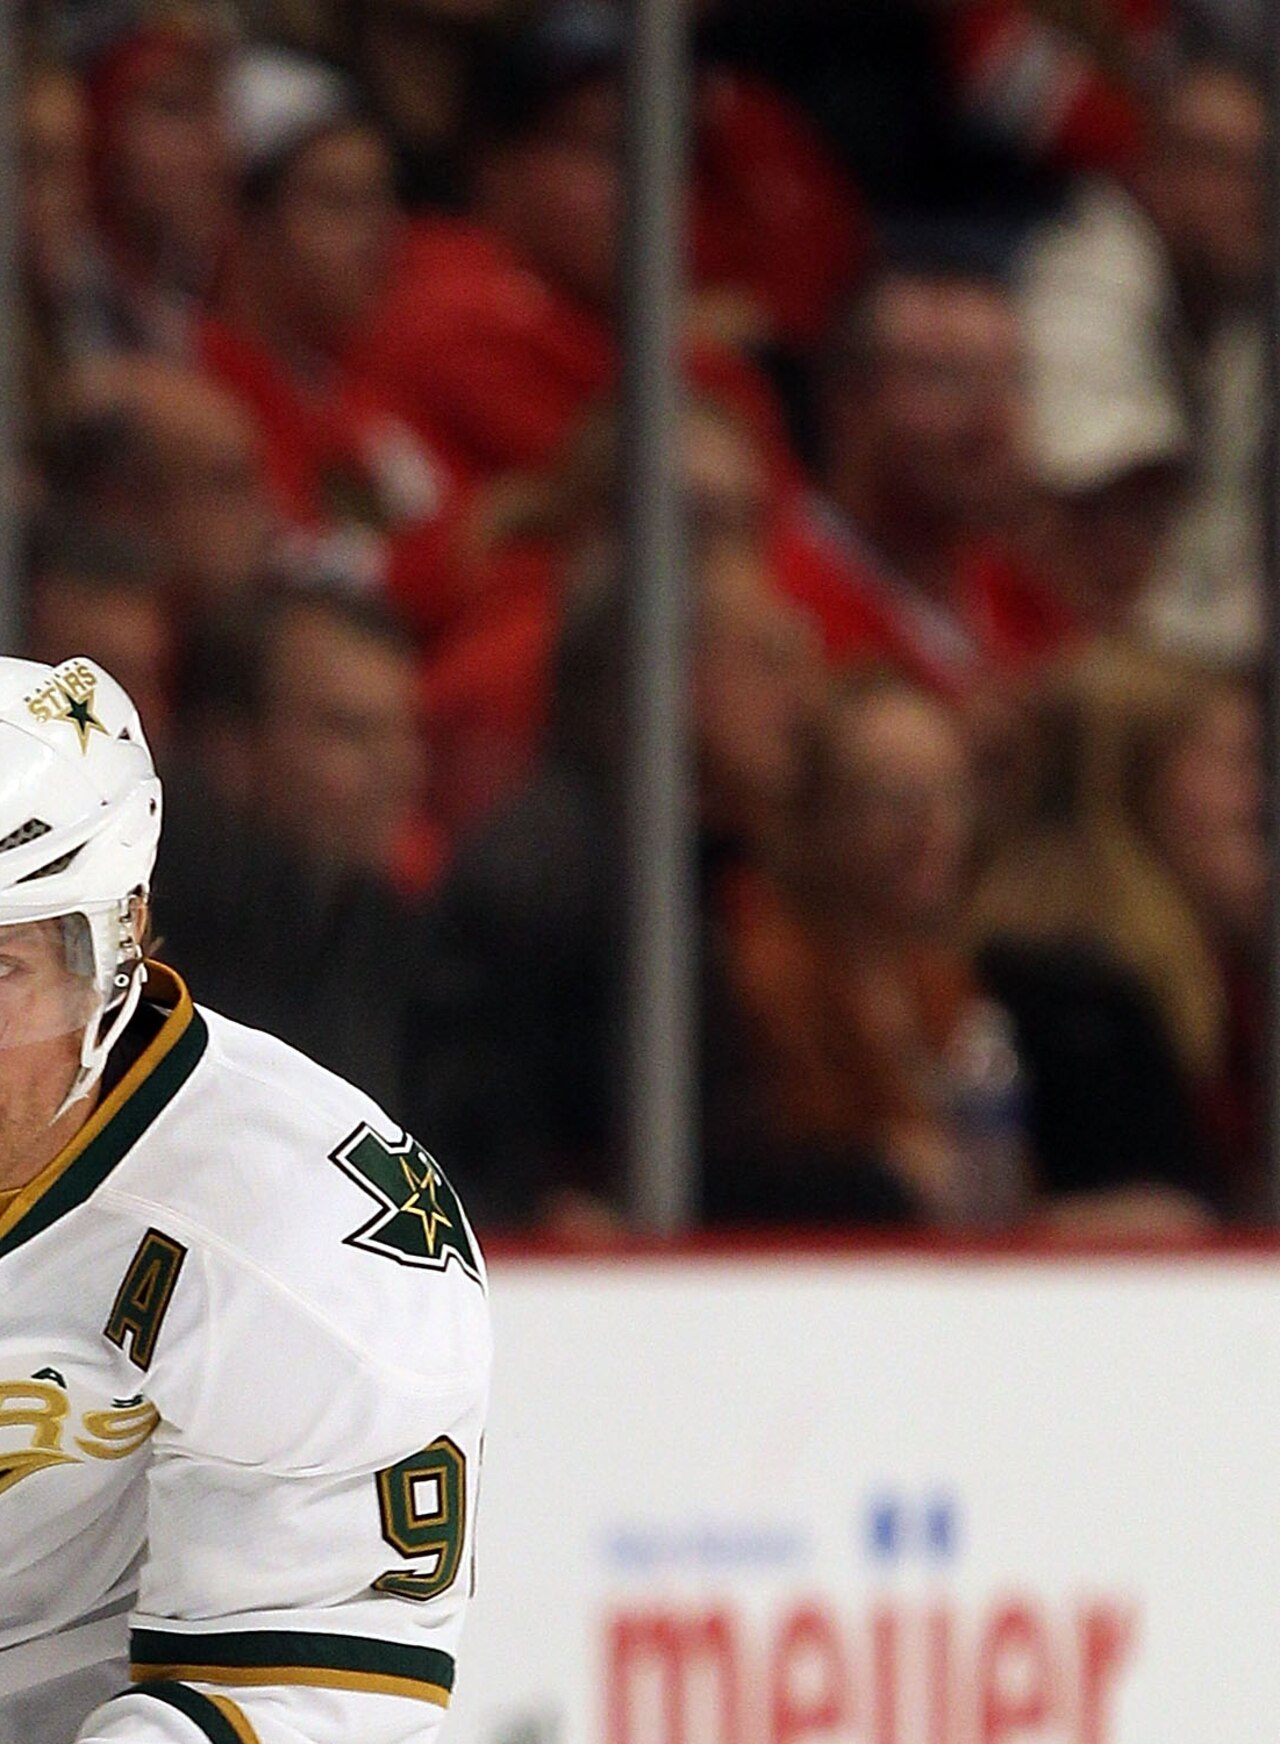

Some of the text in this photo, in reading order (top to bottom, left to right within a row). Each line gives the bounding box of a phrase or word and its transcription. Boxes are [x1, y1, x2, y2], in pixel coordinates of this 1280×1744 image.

[28, 664, 98, 723] STARS
[103, 1226, 188, 1373] A
[372, 1434, 484, 1601] 9
